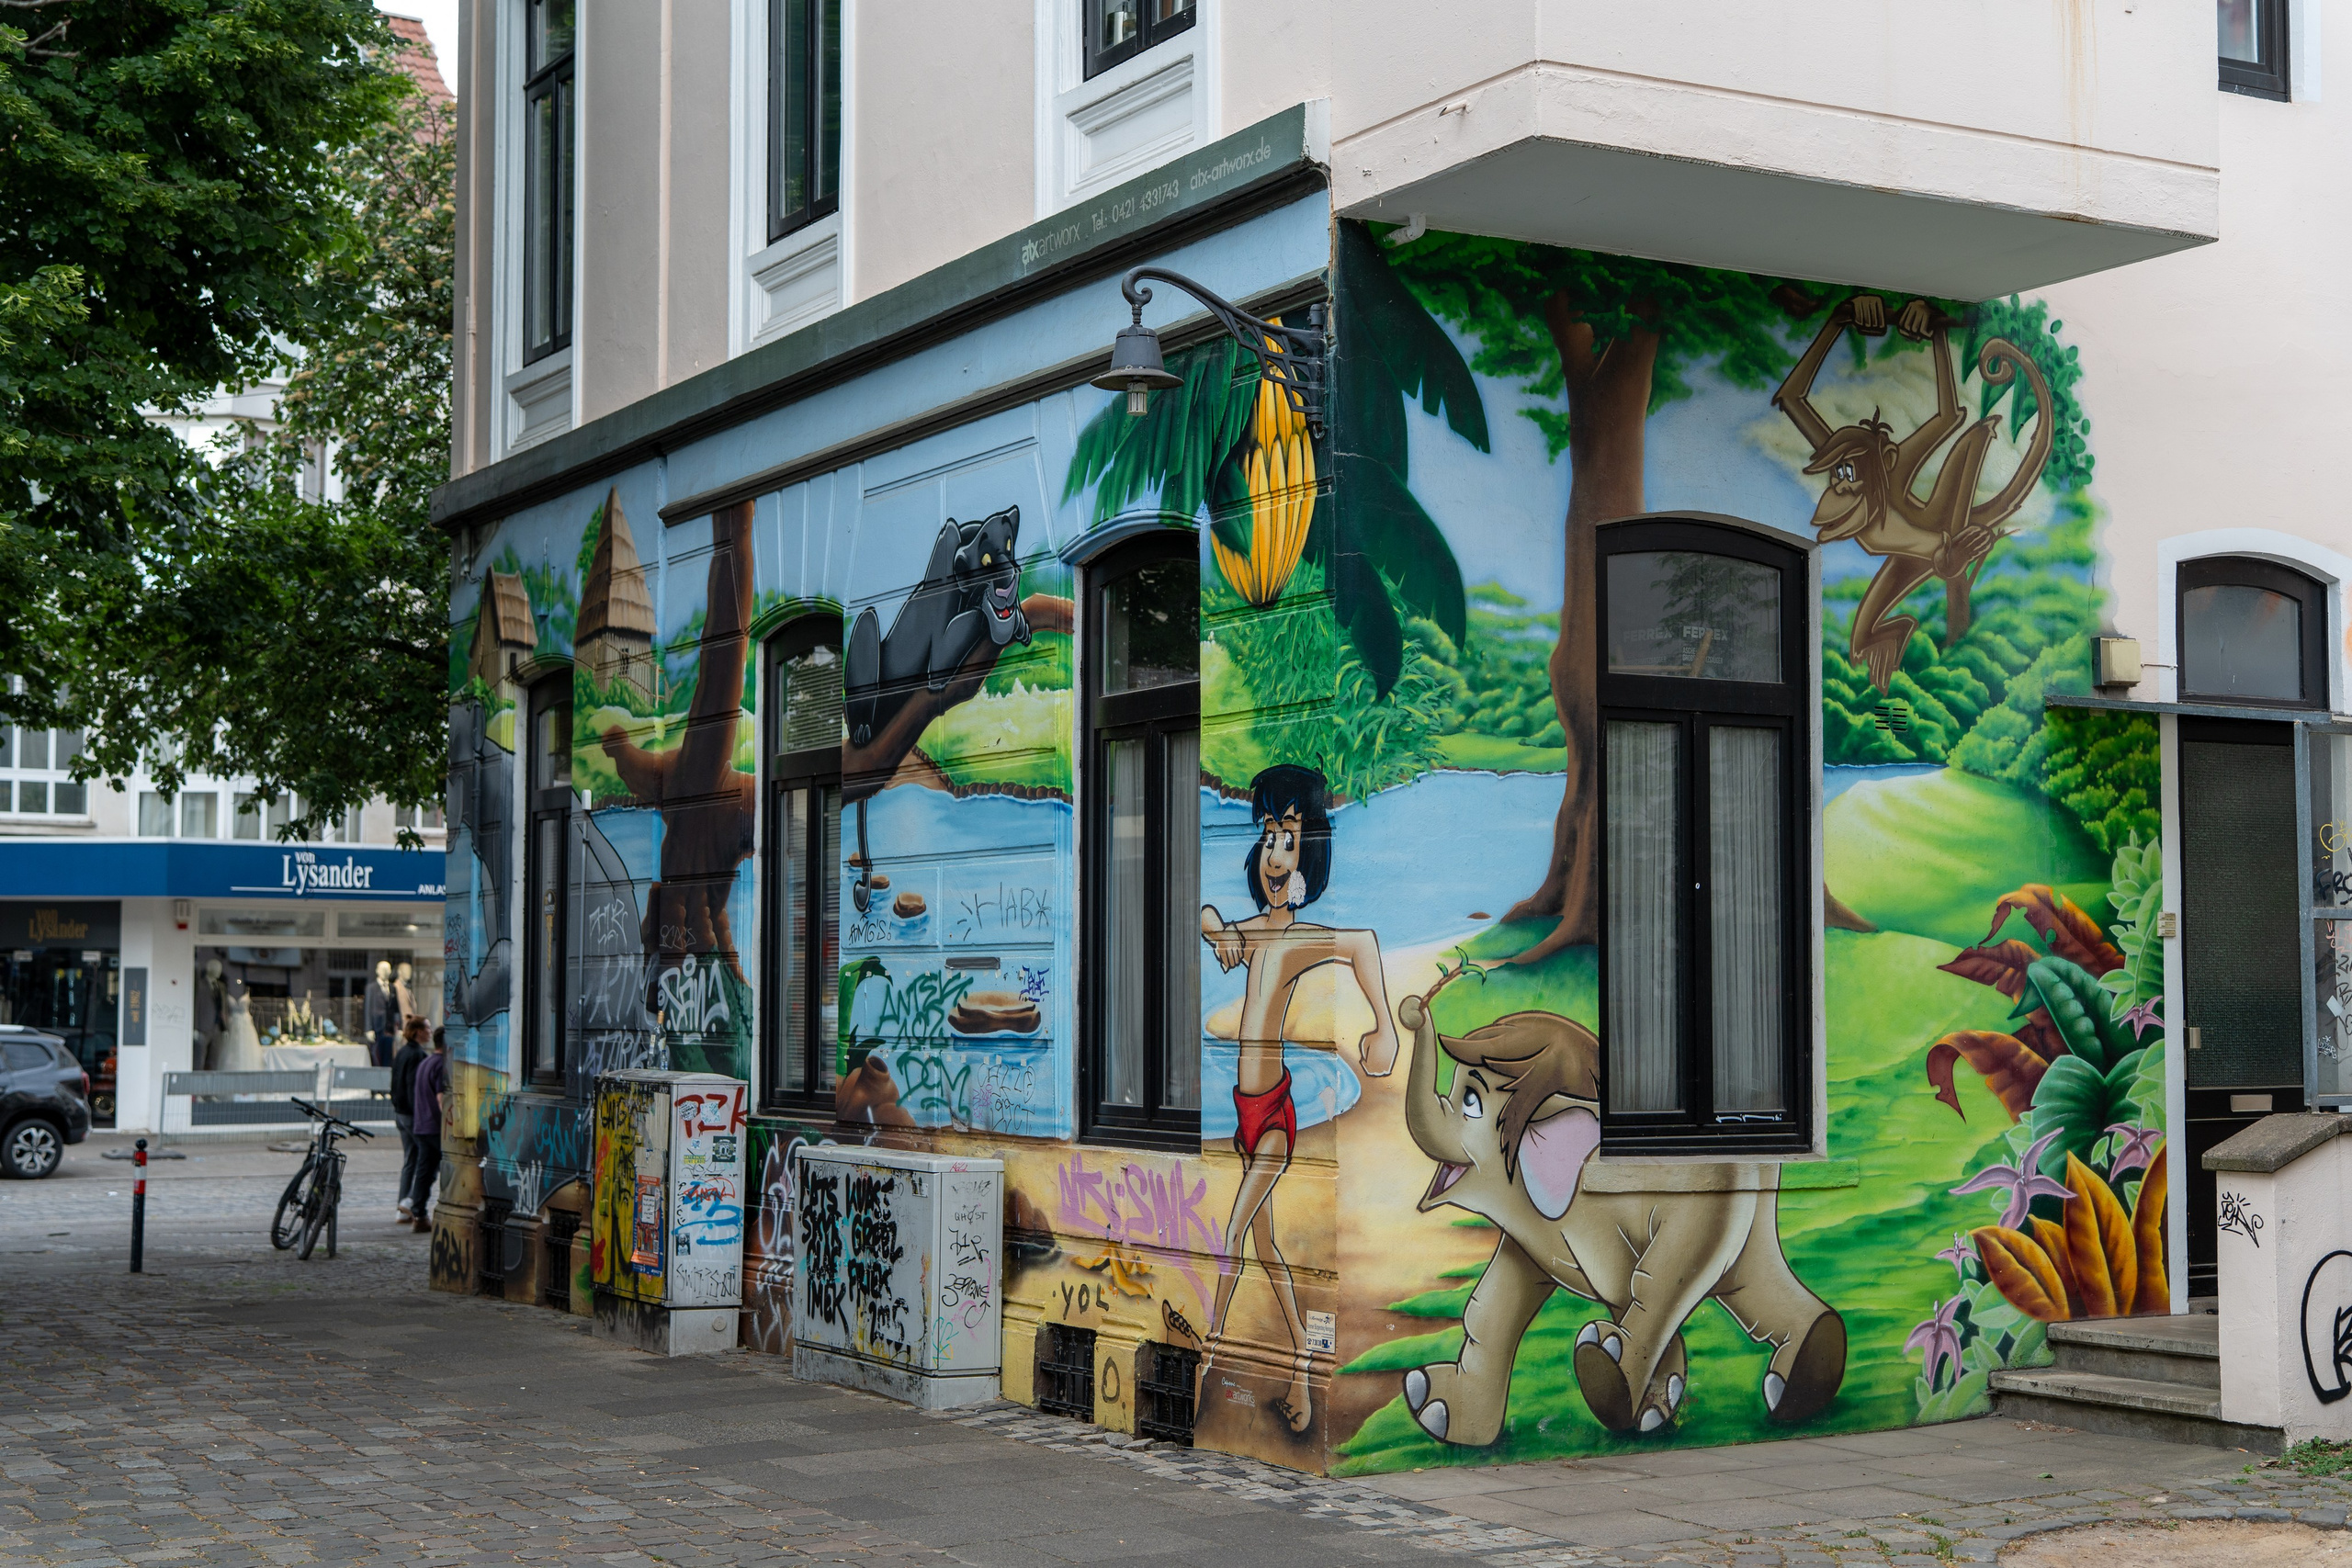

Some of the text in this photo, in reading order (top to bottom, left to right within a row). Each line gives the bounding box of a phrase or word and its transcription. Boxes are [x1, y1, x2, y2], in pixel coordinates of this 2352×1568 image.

[1091, 211, 1109, 234] Tel.:
[1112, 199, 1136, 224] 0421
[1138, 179, 1180, 213] 4331743
[295, 852, 316, 864] von
[282, 854, 373, 896] Lysander
[28, 918, 88, 943] Lysander
